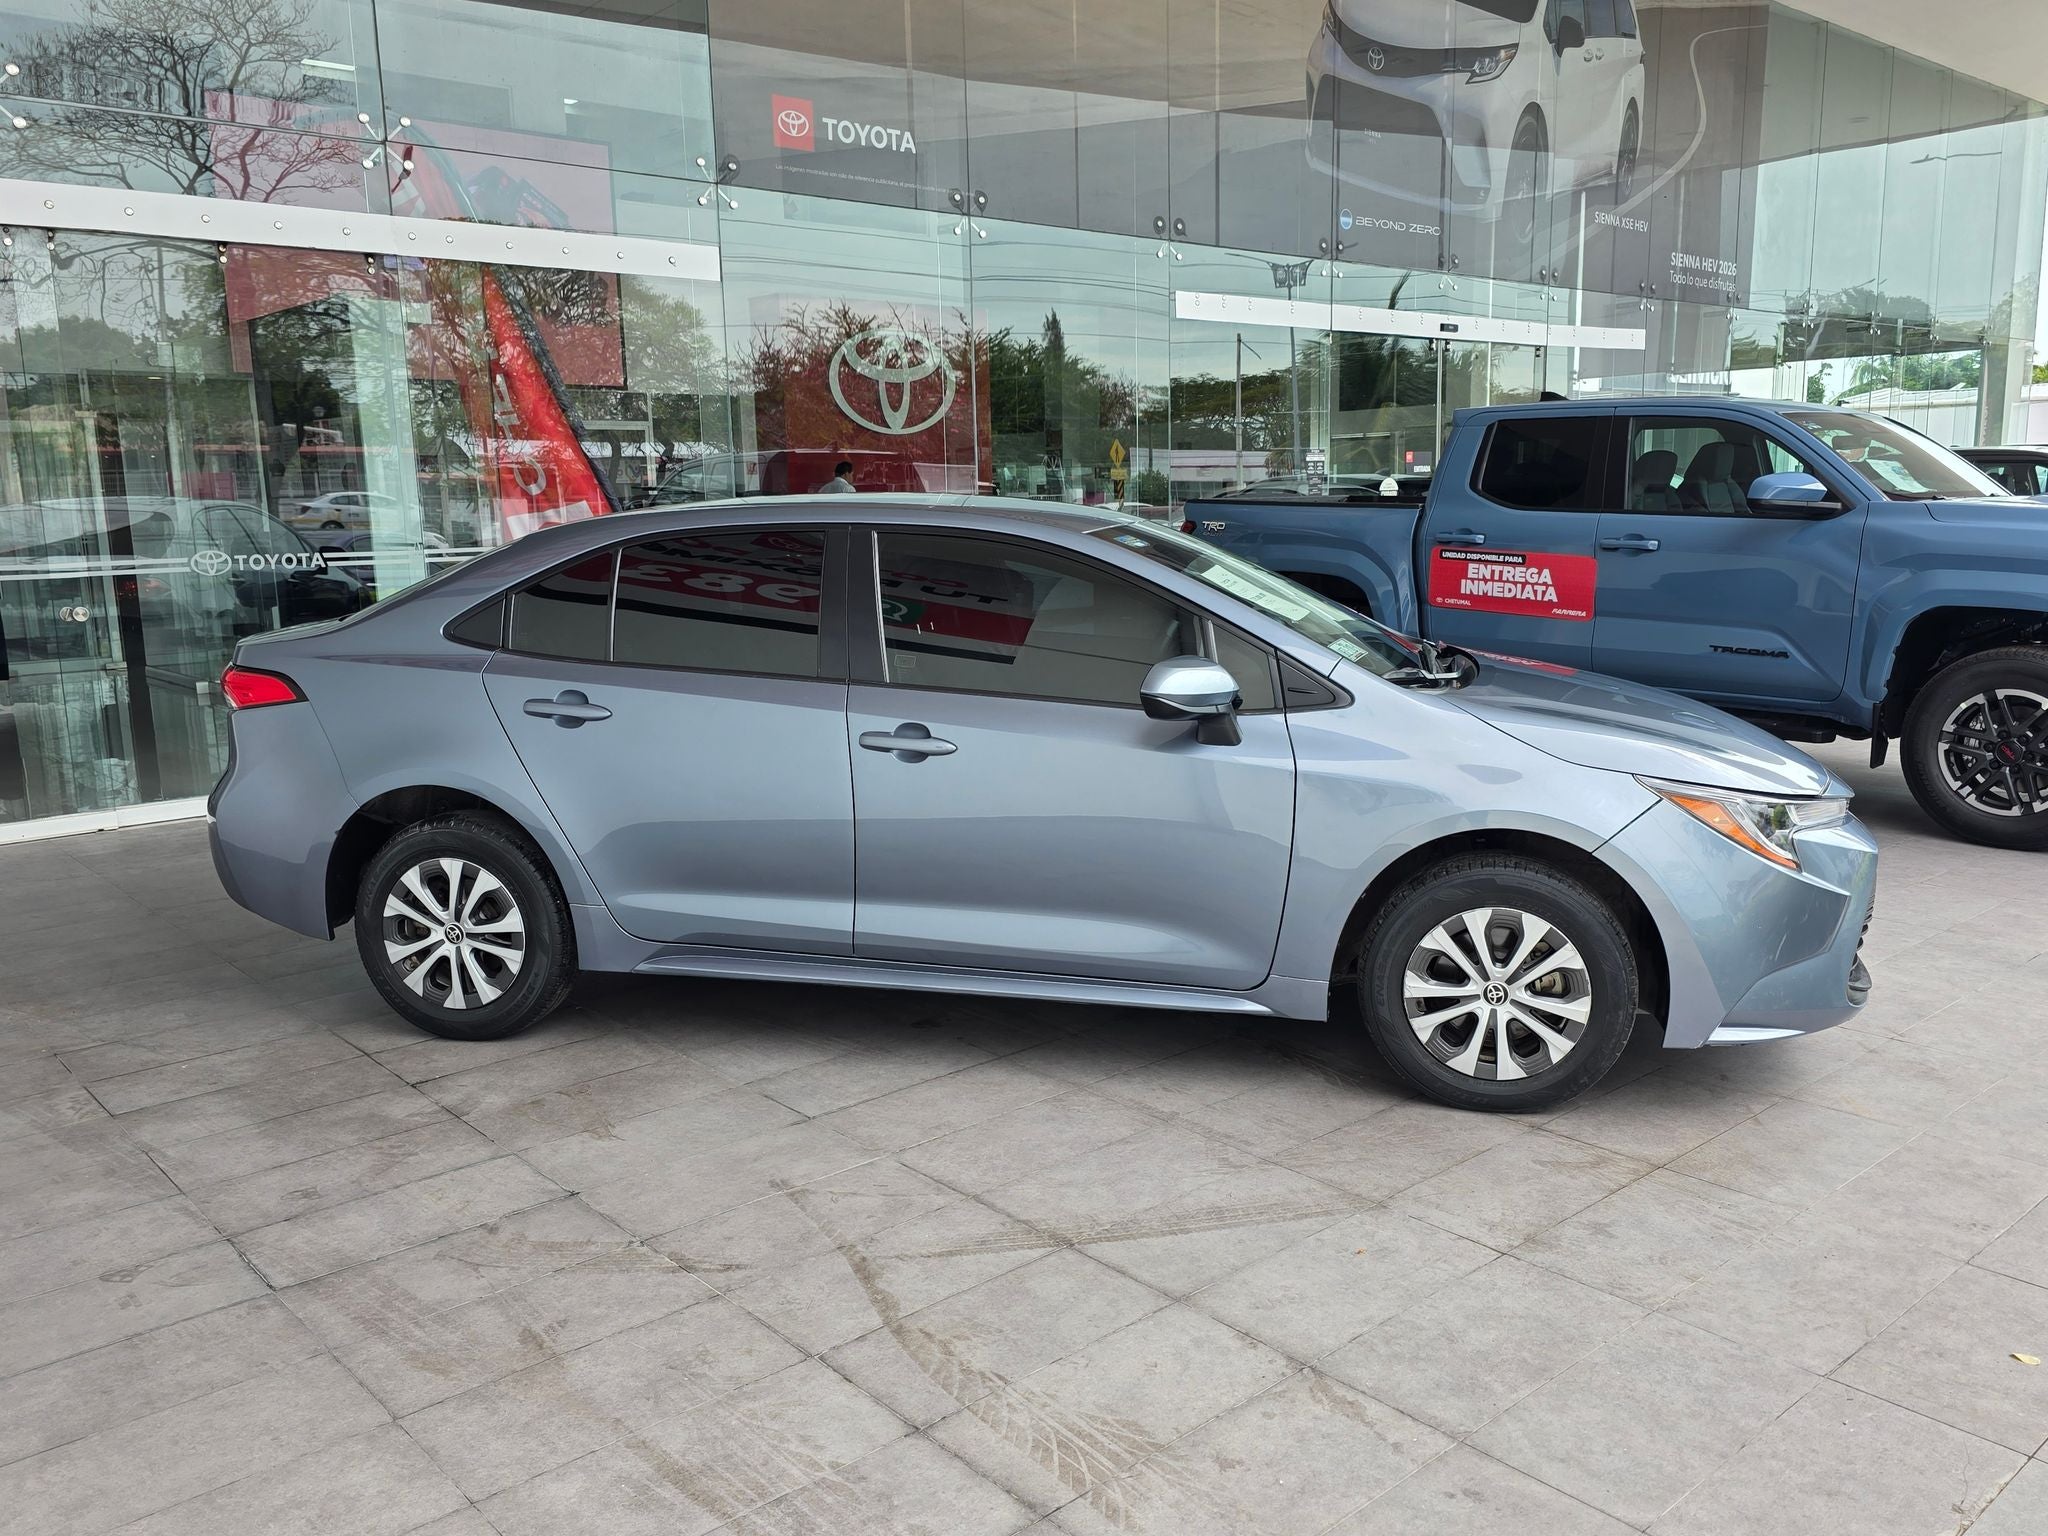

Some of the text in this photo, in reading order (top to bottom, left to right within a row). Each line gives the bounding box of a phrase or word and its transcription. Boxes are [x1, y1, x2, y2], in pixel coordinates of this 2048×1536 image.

[822, 117, 917, 154] TOYOTA
[1355, 216, 1441, 236] BEYOND ZERO
[1594, 211, 1649, 233] SIENNA XSE HEV
[1670, 252, 1737, 276] SIENNA HEV 2026
[1669, 270, 1736, 292] Todo lo que disfrutas
[1202, 520, 1226, 532] TRD
[233, 552, 327, 571] TOYOTA
[1442, 551, 1523, 564] UNIDAD DISPONIBLE PARA
[1467, 563, 1552, 585] ENTREGA
[1460, 579, 1558, 603] INMEDIATA
[1444, 598, 1472, 606] CHETUMAL
[1551, 607, 1587, 618] FARRERA
[1708, 644, 1790, 659] TACOMA
